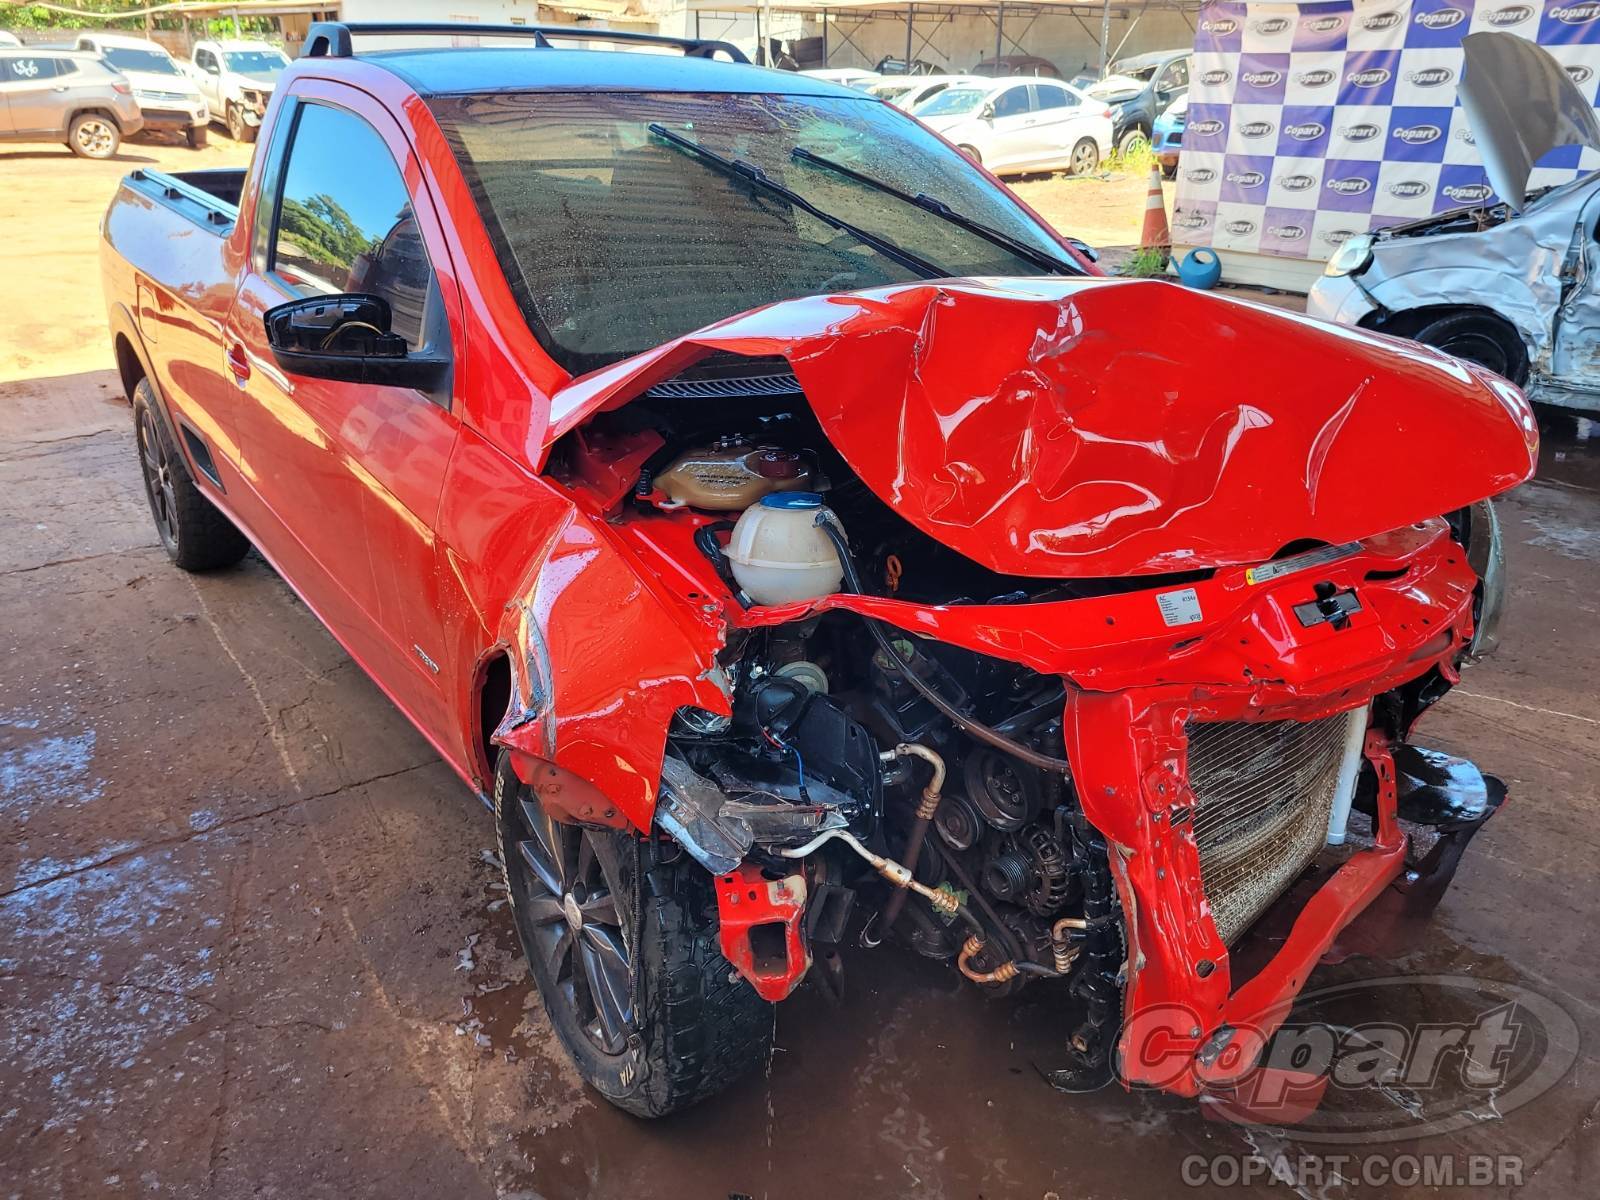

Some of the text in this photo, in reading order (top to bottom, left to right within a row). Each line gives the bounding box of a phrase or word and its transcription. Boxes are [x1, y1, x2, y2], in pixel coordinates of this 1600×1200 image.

[1415, 12, 1460, 25] Copart
[1201, 19, 1233, 32] Copart
[1242, 72, 1276, 85] Copart
[1346, 71, 1386, 84] Copart
[1187, 120, 1219, 133] Copart
[1284, 124, 1319, 137] Copart
[1393, 126, 1435, 140] Copart
[1226, 172, 1261, 186] Copart
[1326, 178, 1365, 192] Copart
[1442, 185, 1487, 200] Copart
[1267, 226, 1302, 239] Copart
